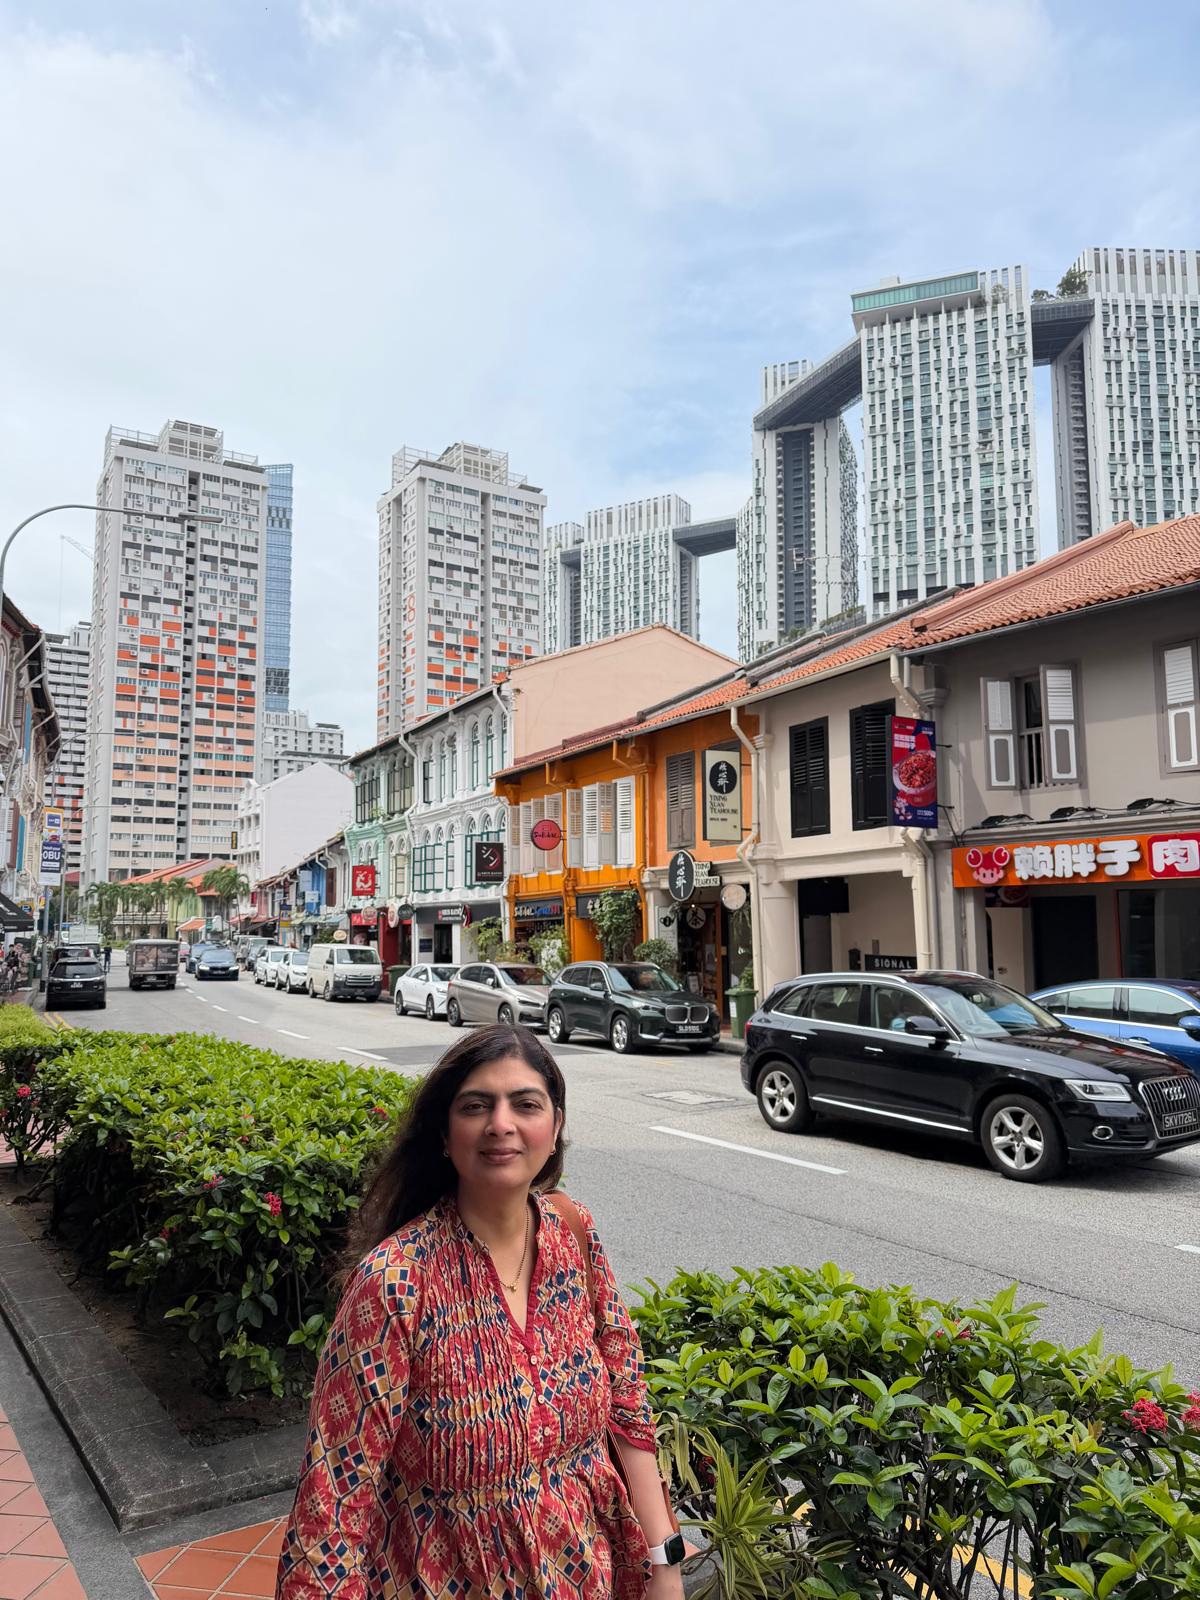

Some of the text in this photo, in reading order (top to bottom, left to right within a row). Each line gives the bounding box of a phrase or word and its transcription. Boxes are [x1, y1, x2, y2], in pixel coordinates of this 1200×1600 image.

[710, 807, 738, 815] TEAHOUSE
[42, 850, 61, 860] OBU
[1151, 838, 1200, 873] 肉
[688, 907, 704, 926] 茶
